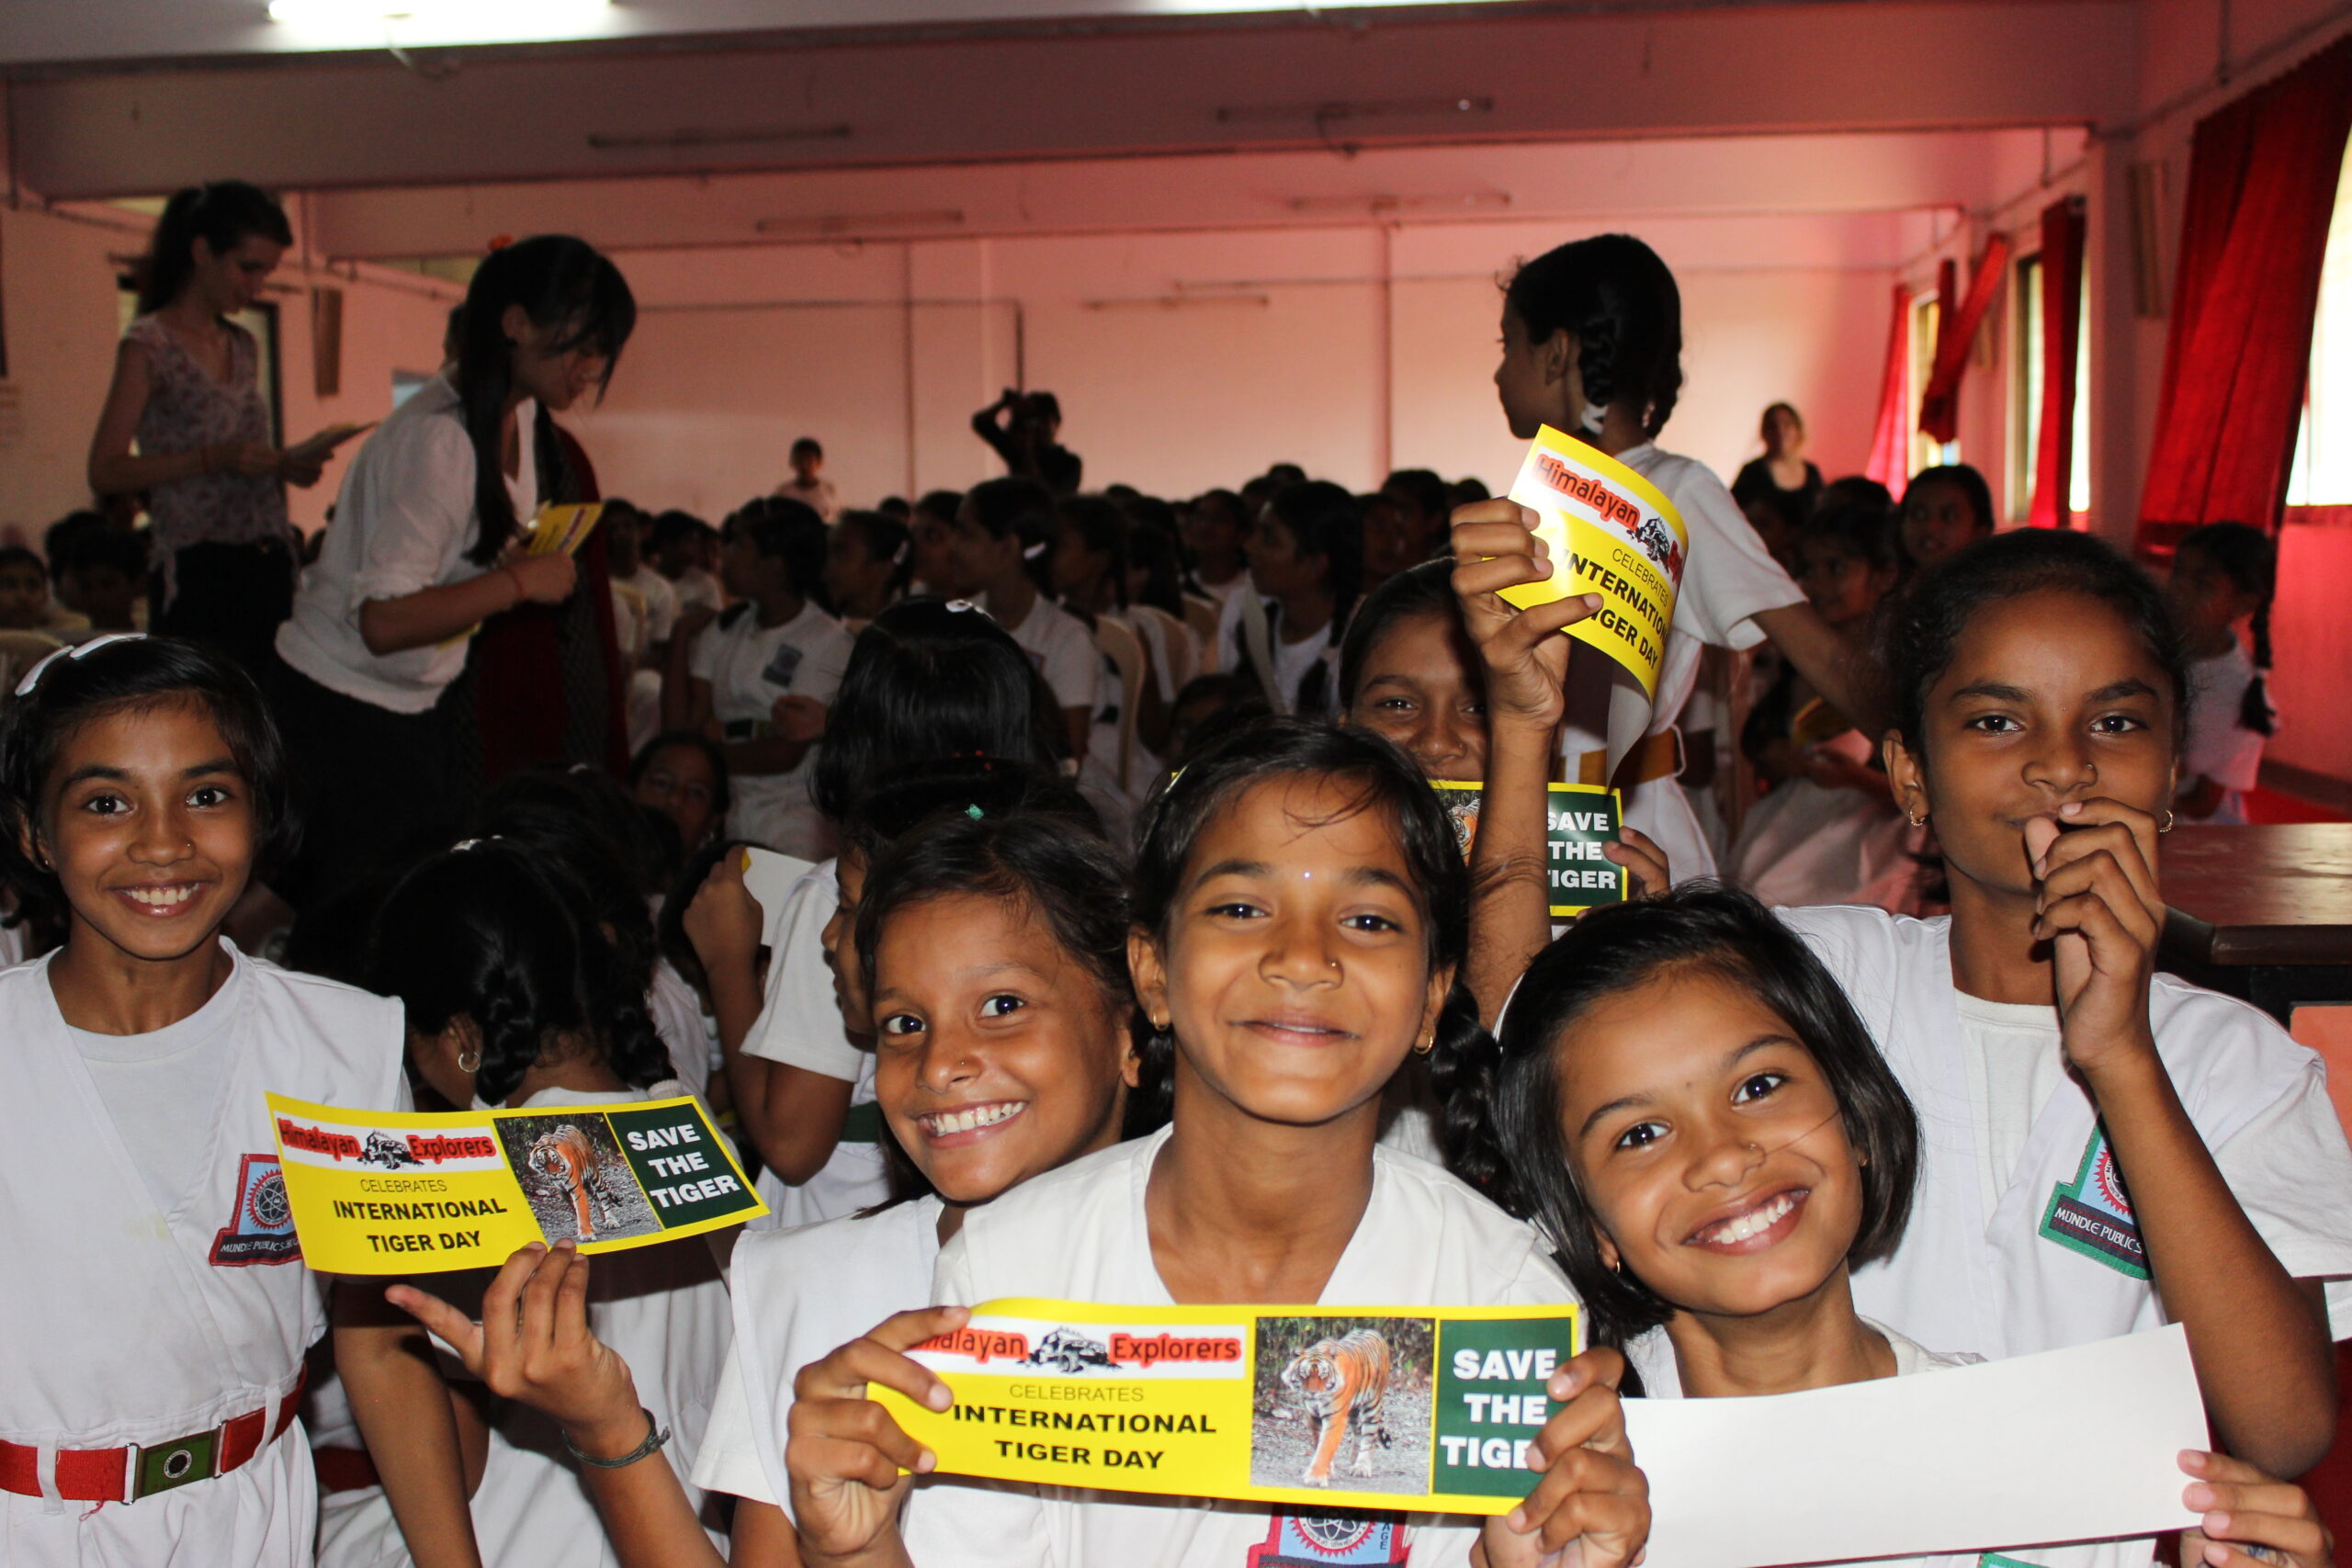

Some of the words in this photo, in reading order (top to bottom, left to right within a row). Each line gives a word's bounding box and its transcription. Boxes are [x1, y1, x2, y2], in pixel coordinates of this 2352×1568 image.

[1537, 457, 1639, 529] Himalayan
[1612, 548, 1668, 607] CELEBRATES
[1589, 609, 1638, 648] GER
[1639, 637, 1657, 670] DAY
[1547, 812, 1609, 831] SAVE
[1547, 840, 1602, 861] THE
[1547, 870, 1616, 889] IGER
[277, 1119, 361, 1160] Himalayan
[409, 1136, 495, 1163] Explorers
[627, 1123, 701, 1151] SAVE
[647, 1151, 709, 1178] THE
[360, 1179, 447, 1192] CELEBRATES
[649, 1175, 741, 1208] TIGER
[333, 1199, 507, 1220] INTERNATIONAL
[367, 1235, 435, 1252] TIGER
[438, 1230, 481, 1249] DAY
[2053, 1206, 2101, 1235] MUNDLE
[2099, 1225, 2136, 1250] PUBLIC
[1114, 1336, 1237, 1365] Explorers
[1453, 1348, 1556, 1380] SAVE
[1010, 1384, 1144, 1402] CELEBRATES
[953, 1404, 1216, 1433] INTERNATIONAL
[1464, 1393, 1547, 1425] THE
[994, 1440, 1091, 1465] TIGER
[1103, 1450, 1164, 1470] DAY
[1440, 1436, 1534, 1470] TIGE
